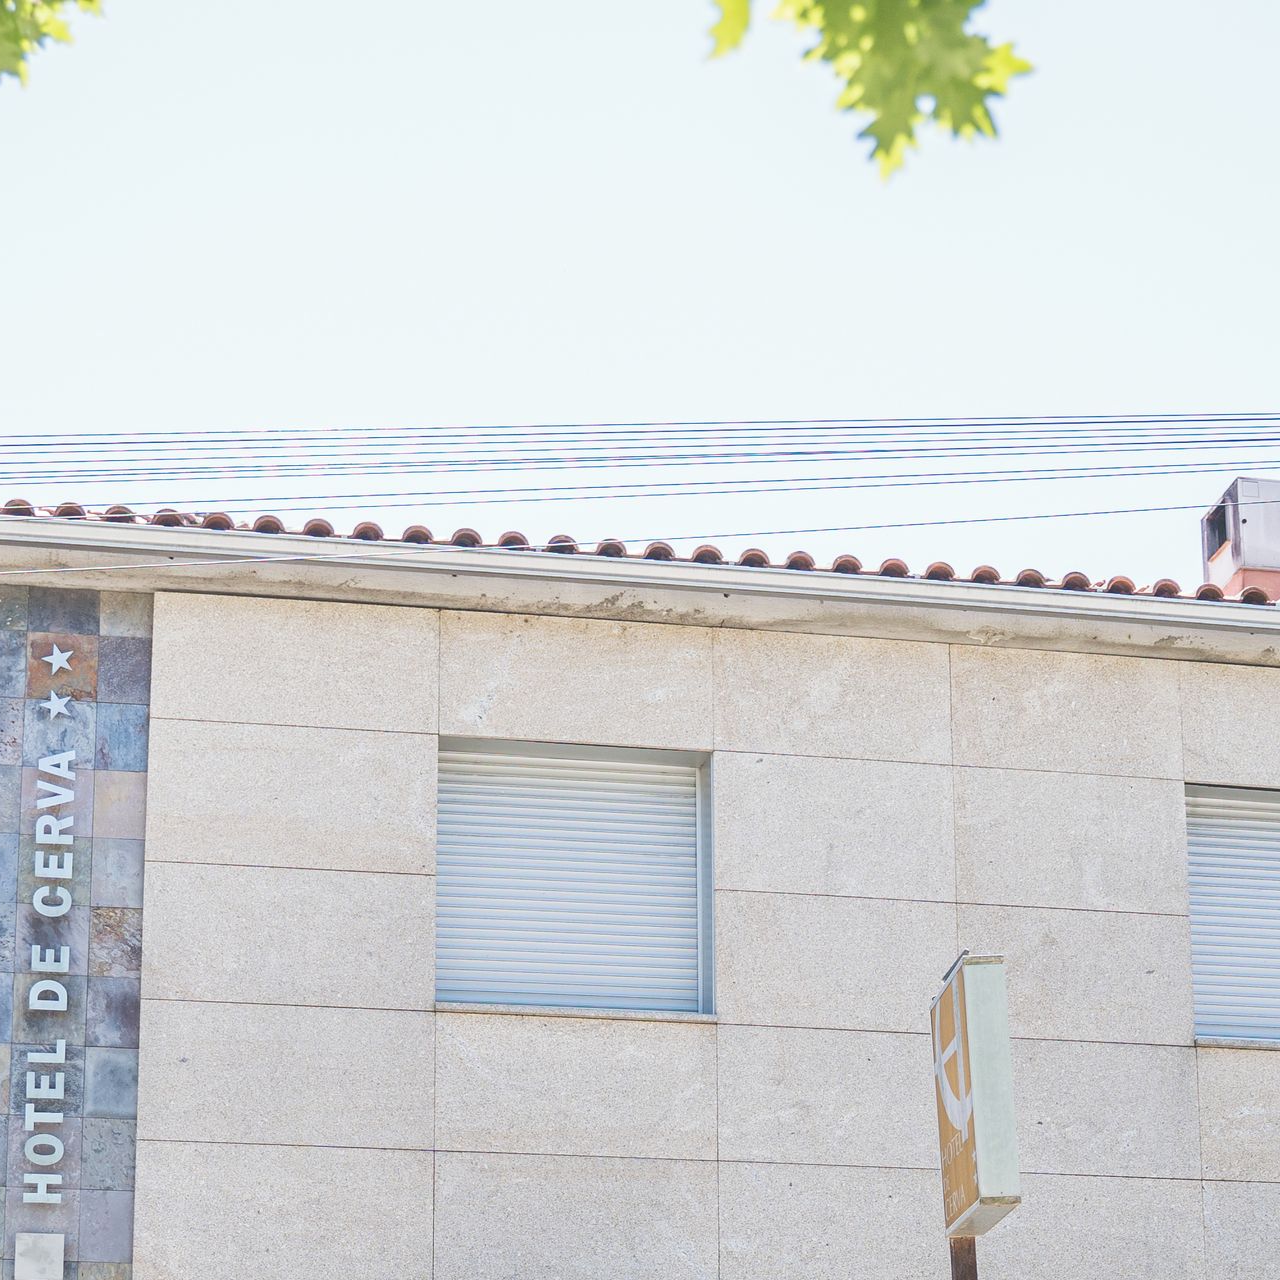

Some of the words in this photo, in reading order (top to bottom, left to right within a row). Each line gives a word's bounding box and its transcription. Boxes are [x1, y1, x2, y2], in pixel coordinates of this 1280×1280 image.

[32, 749, 77, 918] CERVA
[29, 943, 70, 1011] DE
[23, 1037, 67, 1204] HOTEL
